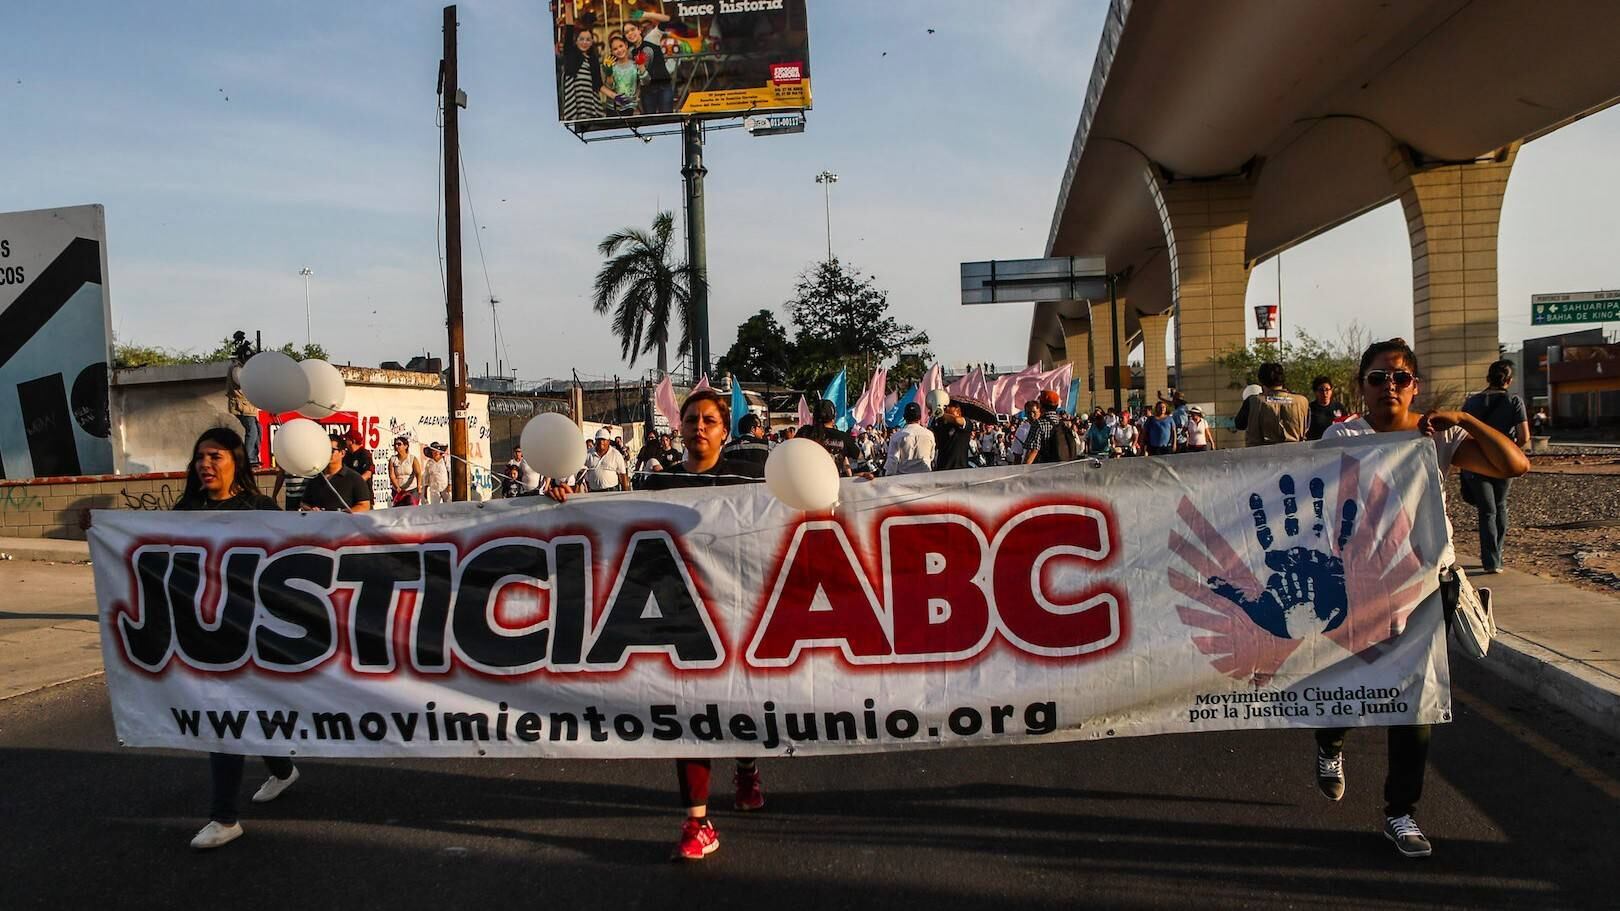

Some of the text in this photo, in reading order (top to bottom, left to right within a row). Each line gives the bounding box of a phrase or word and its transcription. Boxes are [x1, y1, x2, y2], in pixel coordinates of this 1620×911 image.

[677, 0, 783, 17] hace historia
[1546, 310, 1614, 322] BAHIA DE KINO
[1562, 301, 1620, 312] SAHUARIPA
[361, 416, 380, 449] 15
[117, 504, 1120, 675] JUSTICIA ABC
[1195, 685, 1400, 705] Movimiento Ciudadano
[1188, 698, 1408, 722] por la Justicia 5 de Junio
[172, 698, 1057, 749] www.movimiento5dejunio.org
